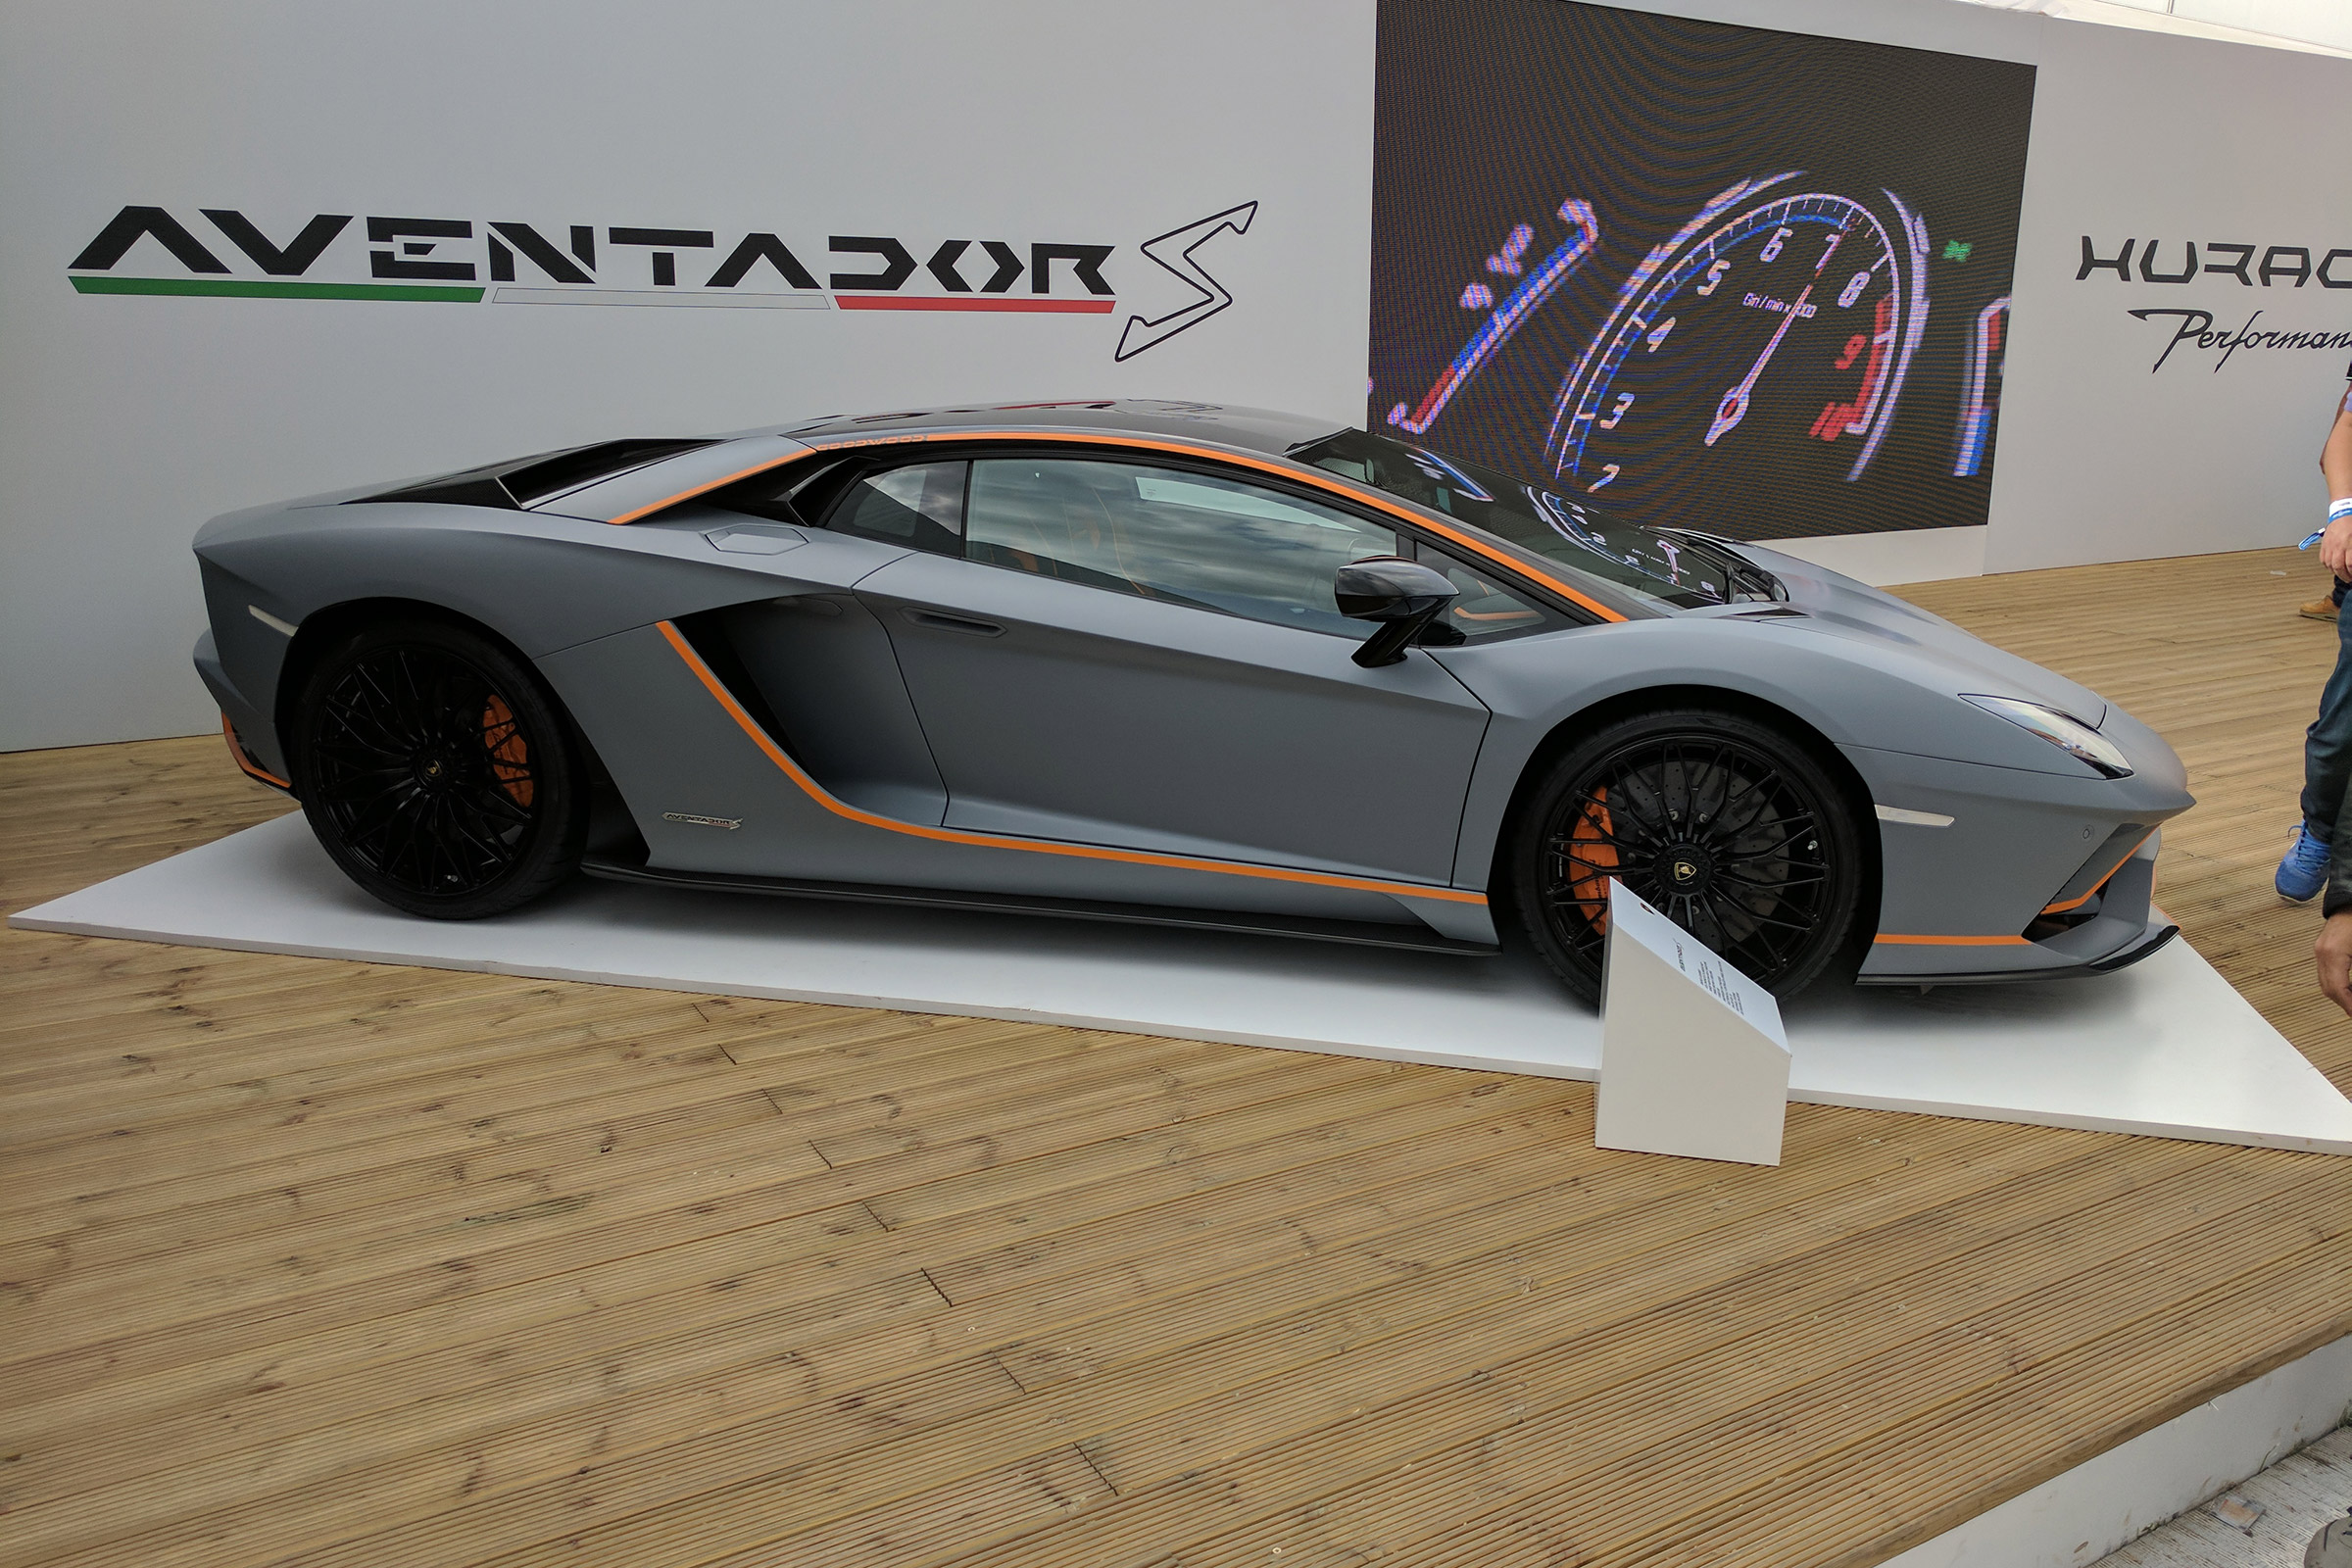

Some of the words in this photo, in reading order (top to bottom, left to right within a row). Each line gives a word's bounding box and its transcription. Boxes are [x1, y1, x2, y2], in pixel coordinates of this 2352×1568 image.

[67, 205, 1116, 296] AVENTADOR
[1759, 226, 1793, 263] 6
[1815, 233, 1841, 270] 7
[1696, 259, 1732, 297] 5
[1837, 270, 1871, 309] 8
[1646, 317, 1677, 353] 4
[1835, 333, 1867, 370] 9
[1598, 392, 1636, 430] 3
[665, 813, 730, 825] AVENTADOR
